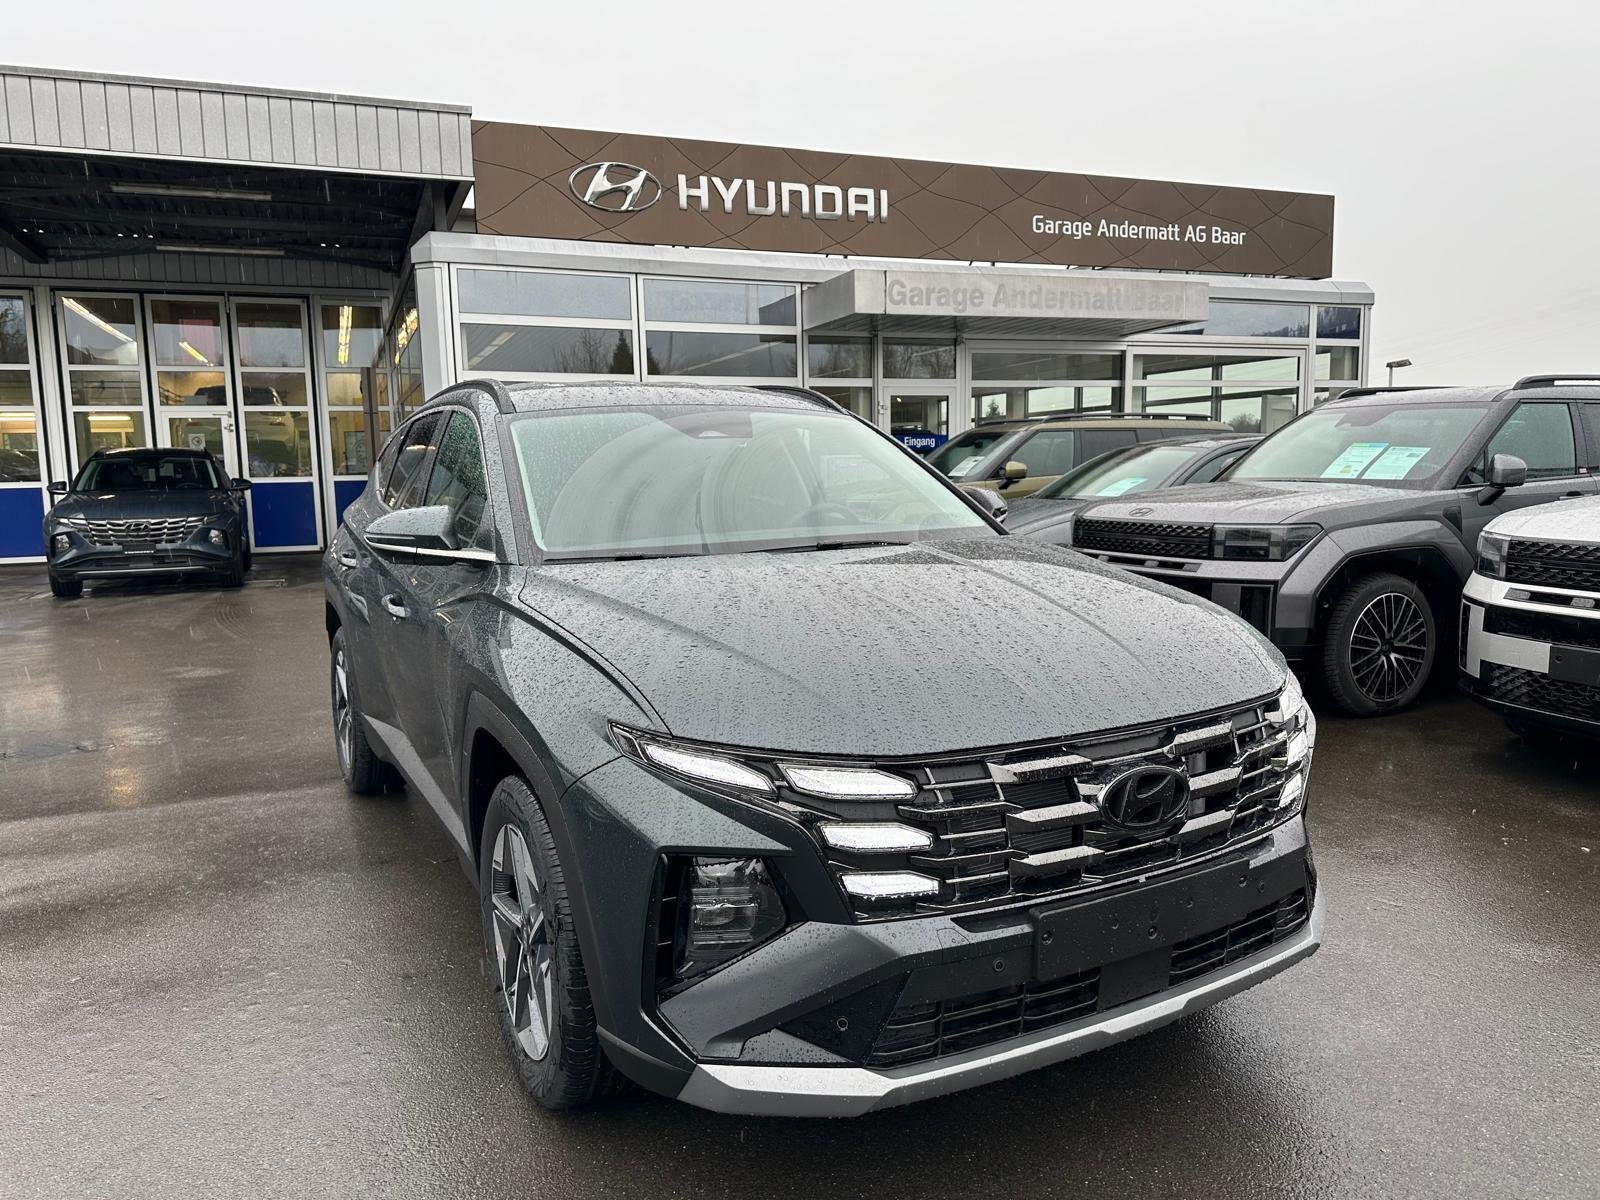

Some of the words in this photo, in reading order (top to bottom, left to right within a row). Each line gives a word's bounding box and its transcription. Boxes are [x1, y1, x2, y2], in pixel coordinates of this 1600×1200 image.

[677, 173, 889, 223] HYUNDAI
[1032, 215, 1092, 239] Garage
[1097, 219, 1180, 241] Andermatt
[1184, 225, 1207, 243] AG
[1211, 227, 1246, 245] Baar
[888, 279, 985, 313] Garage
[992, 283, 1122, 311] Andermatt
[904, 436, 936, 448] Eingang
